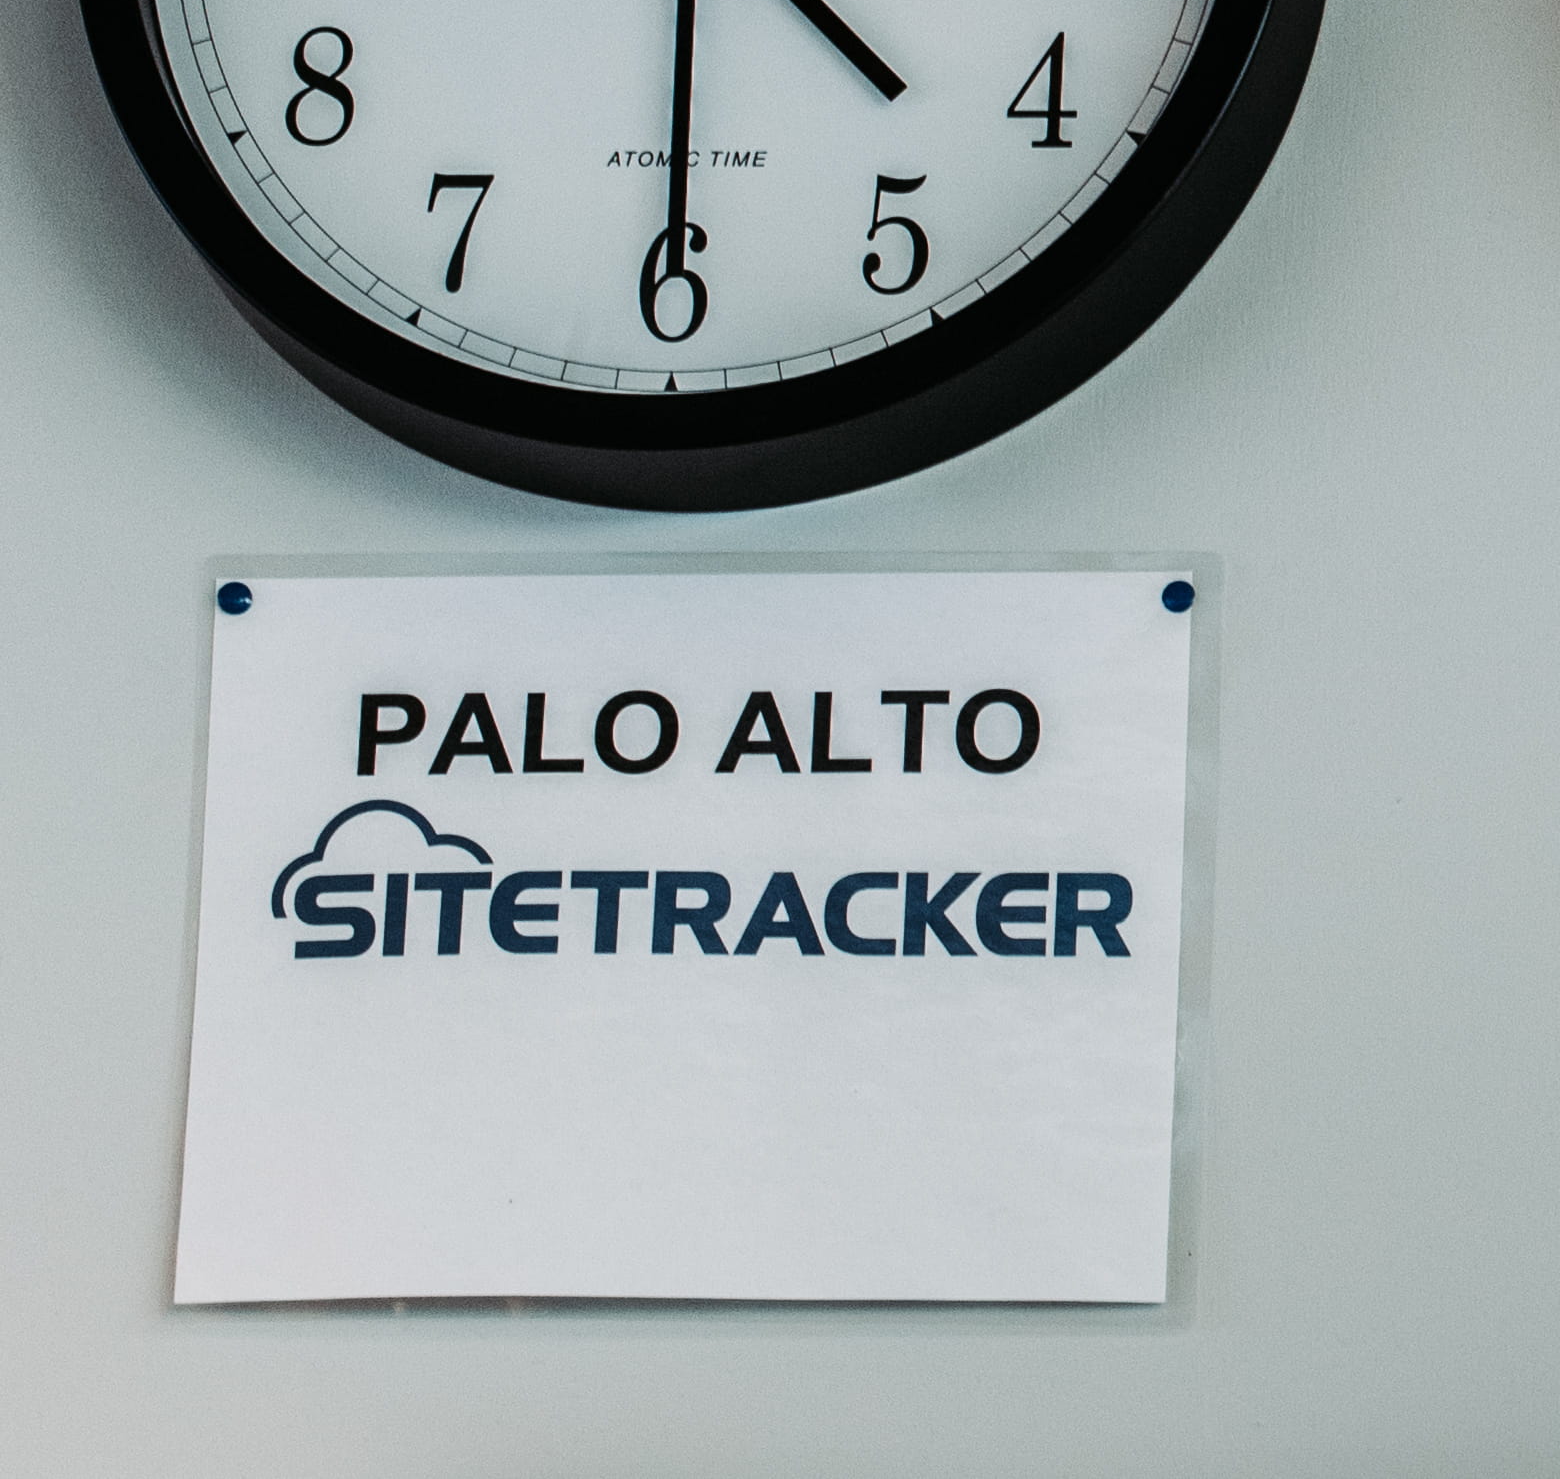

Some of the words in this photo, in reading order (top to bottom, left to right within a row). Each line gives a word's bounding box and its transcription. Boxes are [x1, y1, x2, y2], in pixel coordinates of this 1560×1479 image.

[285, 27, 354, 146] 8
[1007, 32, 1077, 148] 4
[607, 151, 700, 167] ATOMC
[711, 151, 768, 167] TIME
[428, 173, 494, 293] 7
[639, 220, 707, 343] 6
[863, 175, 928, 295] 5
[357, 690, 678, 776] PALO
[715, 689, 1040, 774] ALTO
[292, 867, 1135, 960] SITETRACKER
